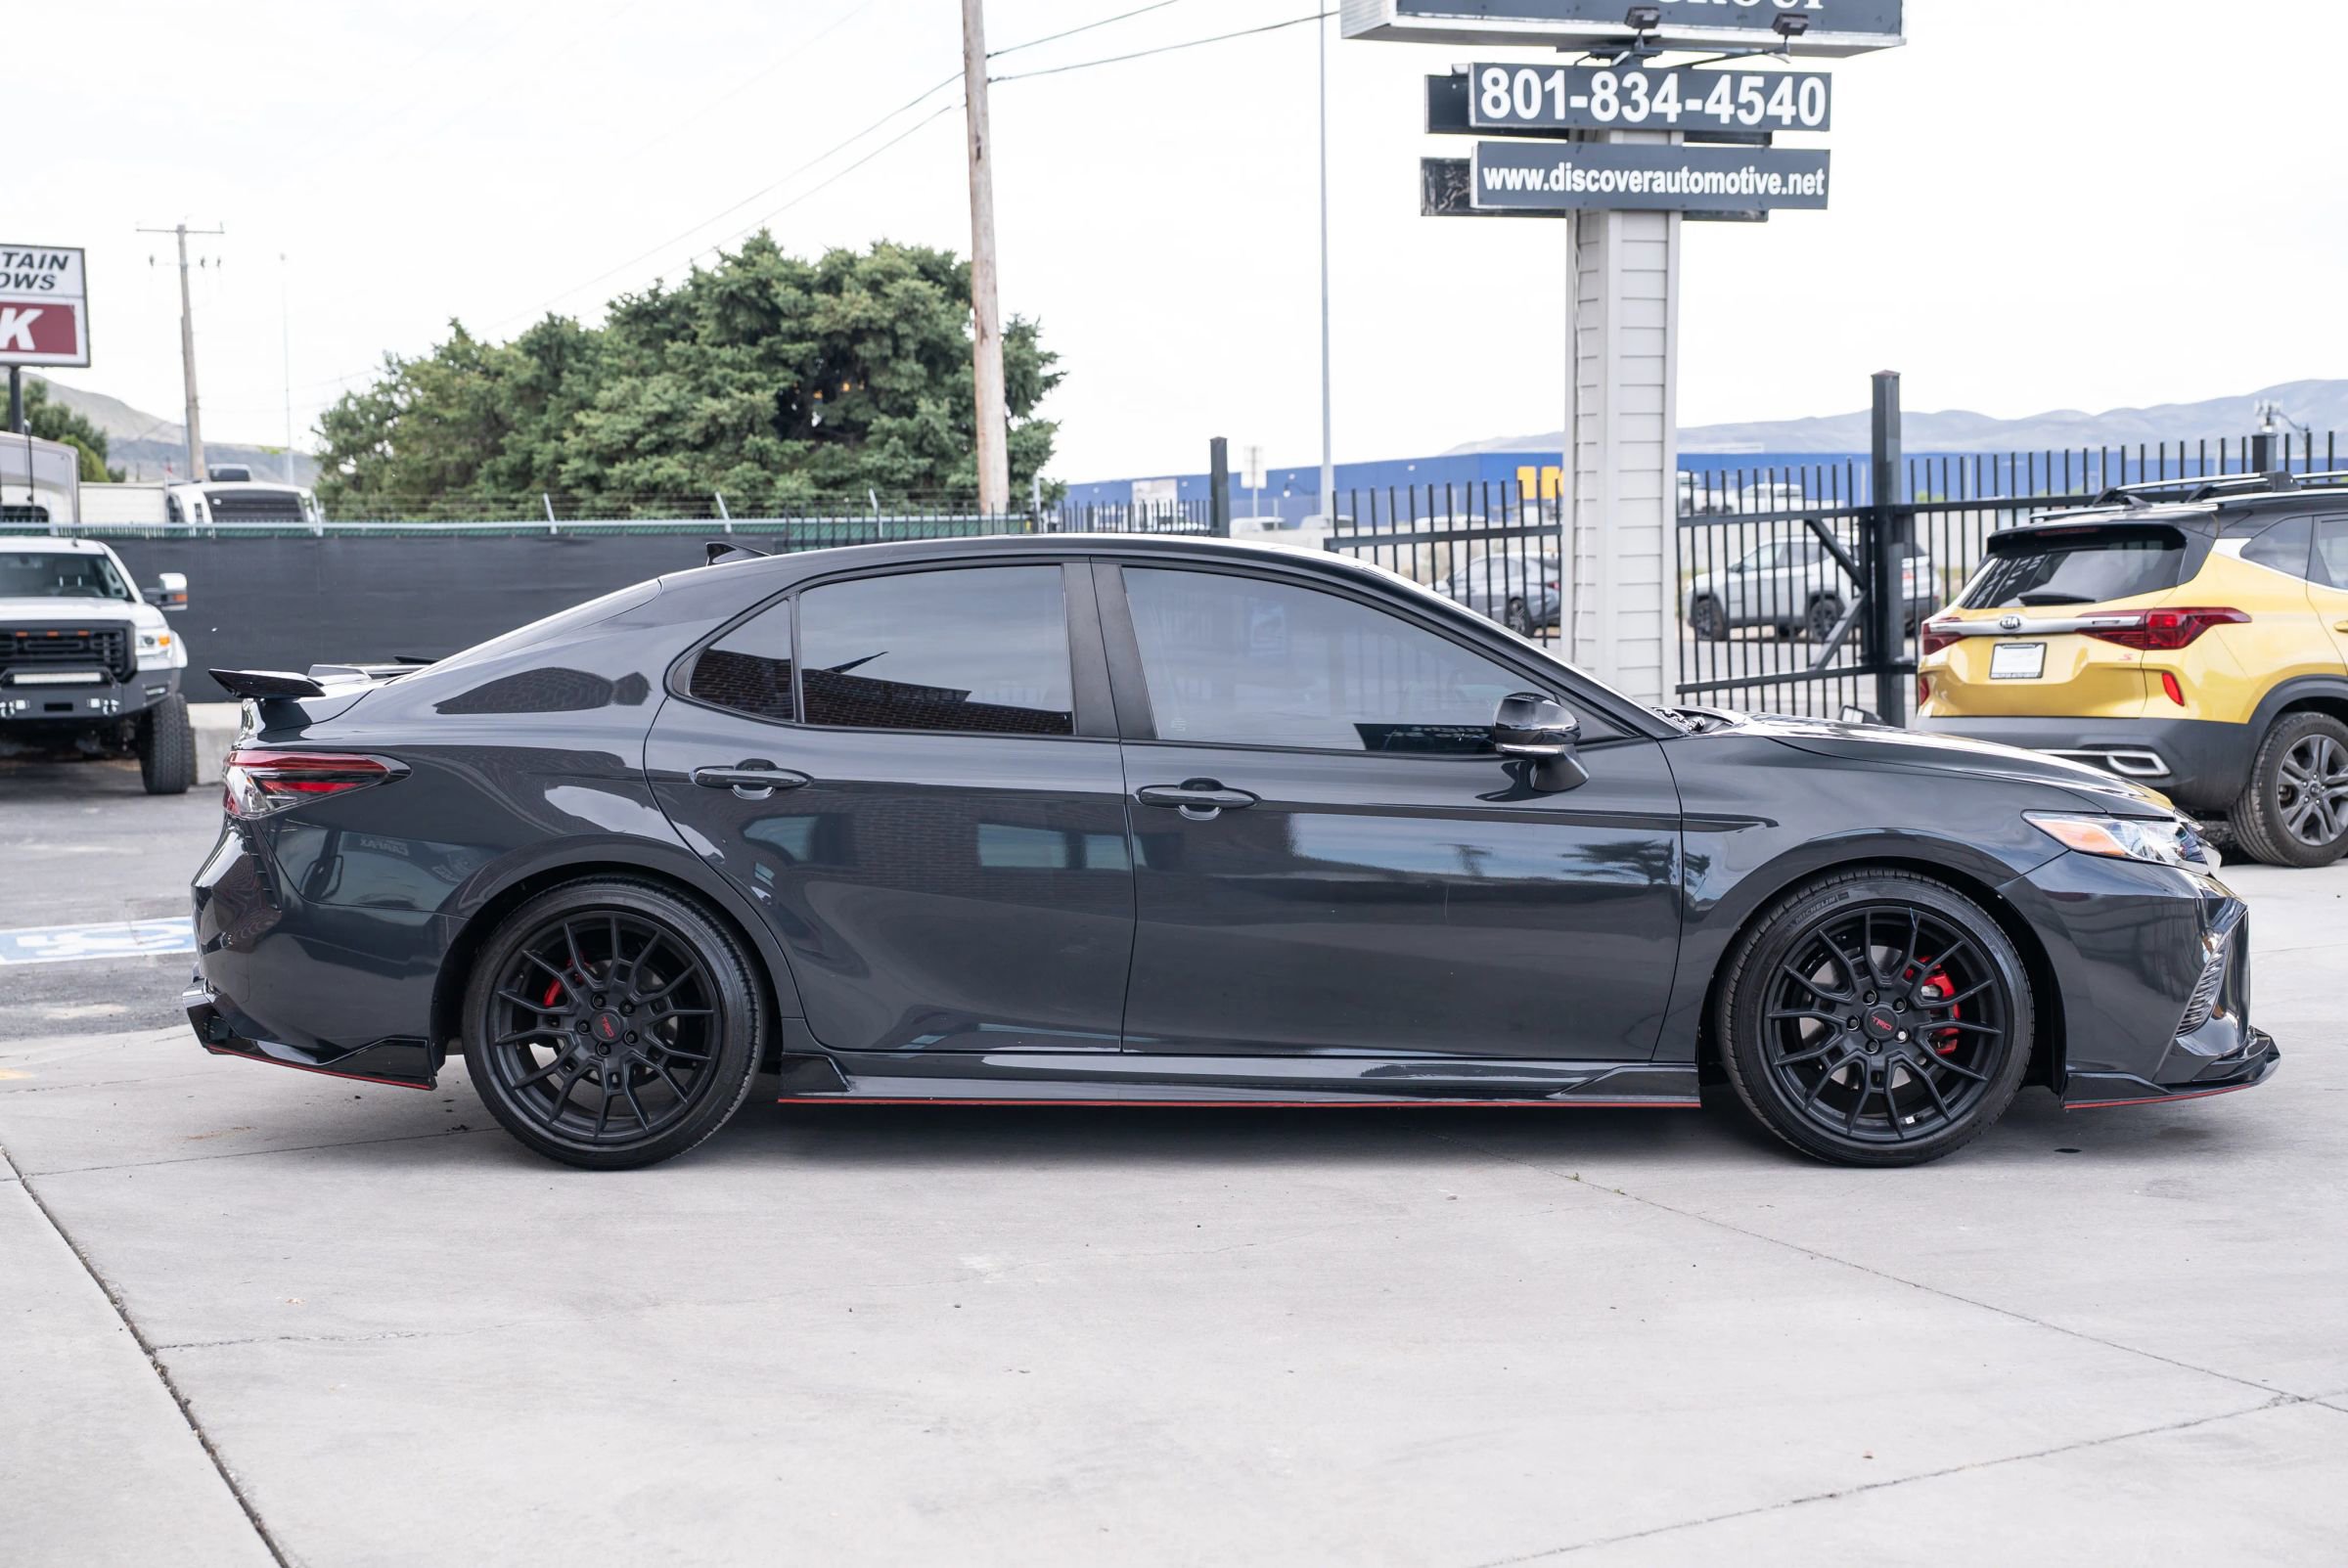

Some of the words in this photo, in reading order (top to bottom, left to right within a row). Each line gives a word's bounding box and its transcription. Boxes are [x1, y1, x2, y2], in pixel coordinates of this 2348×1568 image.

[1480, 67, 1827, 126] 801-834-4540
[1482, 161, 1826, 196] www.discoverautomotive.net
[1872, 1015, 1892, 1031] TRD
